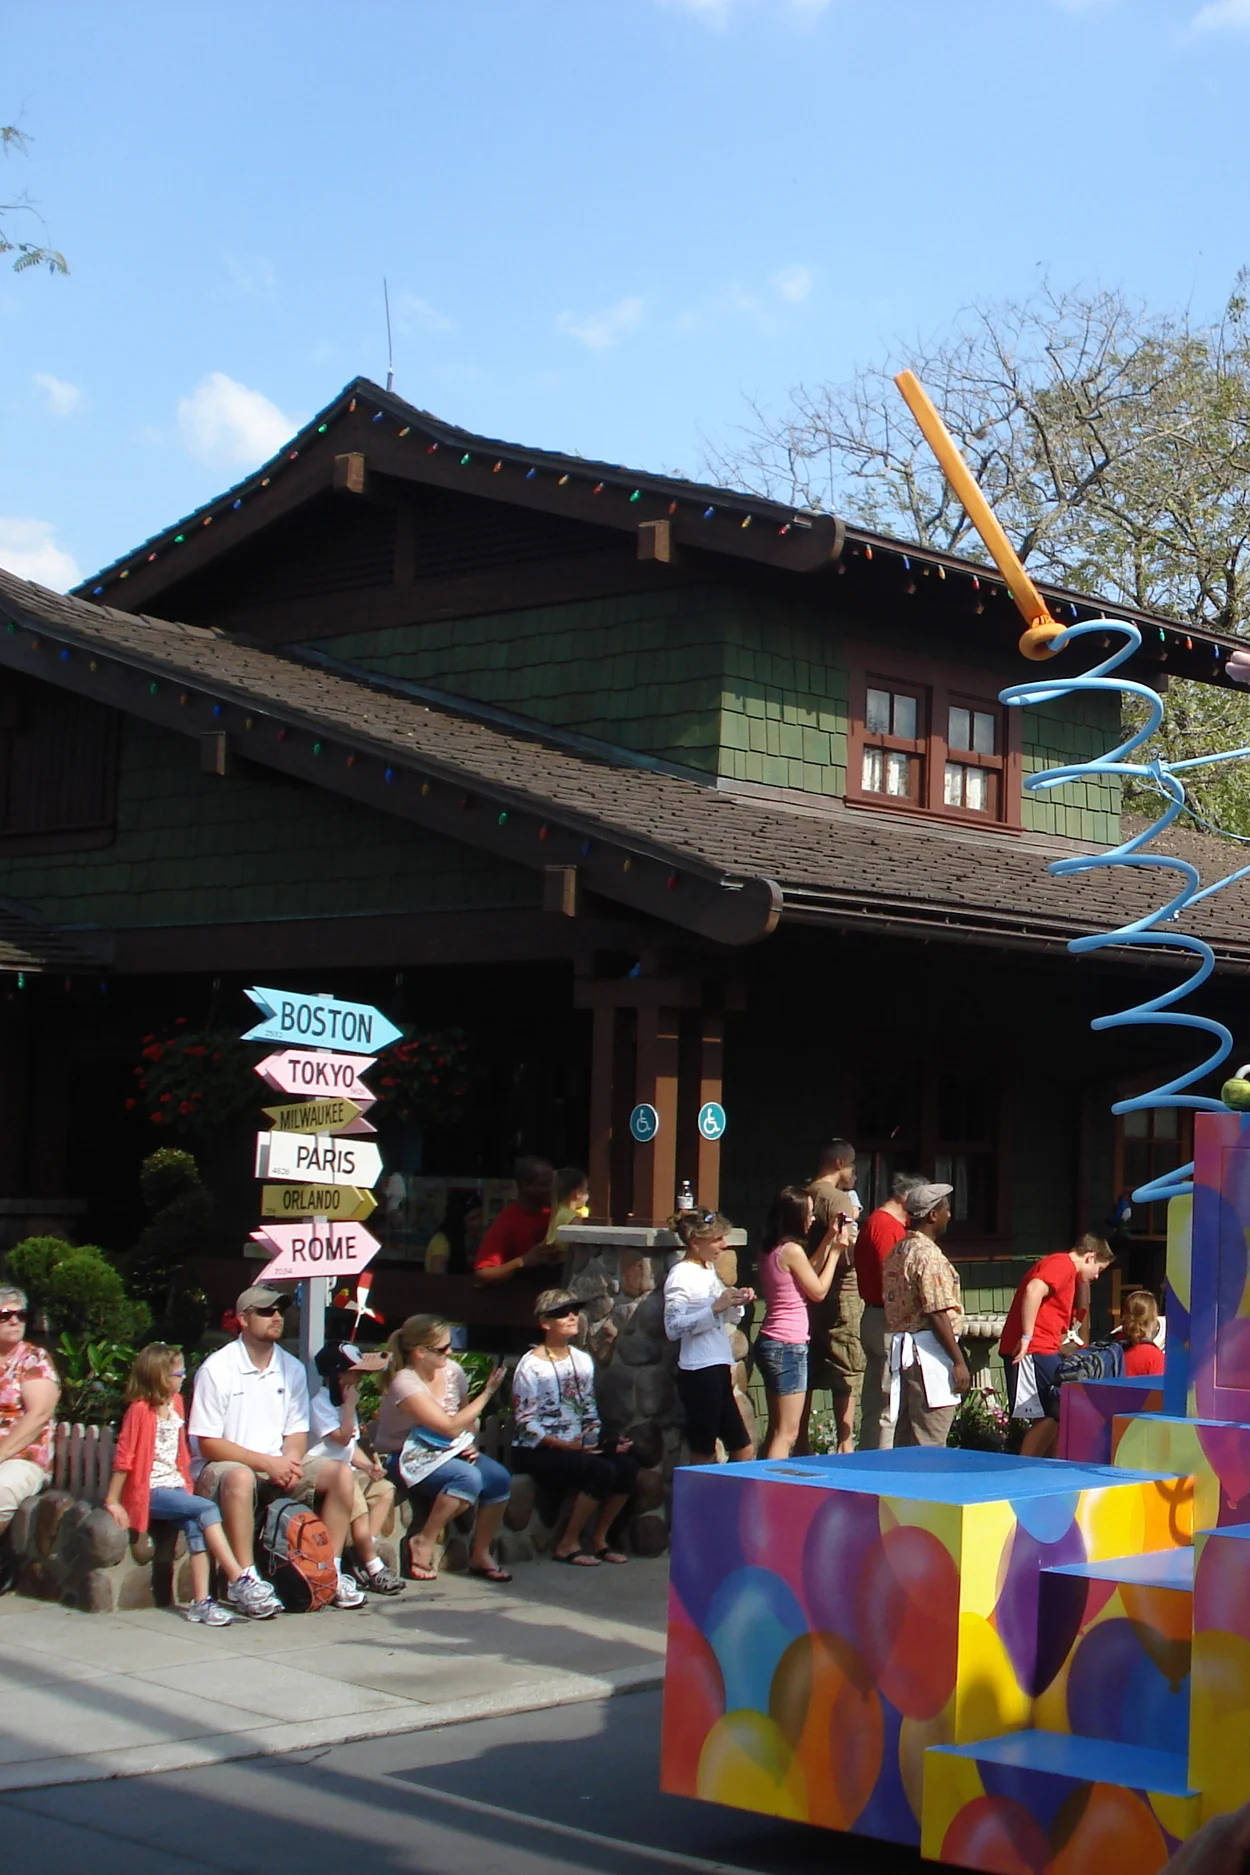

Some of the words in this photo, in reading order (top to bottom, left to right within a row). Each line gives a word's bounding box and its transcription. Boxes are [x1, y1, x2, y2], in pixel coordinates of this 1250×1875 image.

[281, 1001, 373, 1044] BOSTON
[288, 1059, 355, 1088] TOKYO
[280, 1102, 344, 1130] MILWAUKEE
[296, 1146, 356, 1175] PARIS
[282, 1188, 341, 1211] ORLANDO
[291, 1236, 358, 1263] ROME
